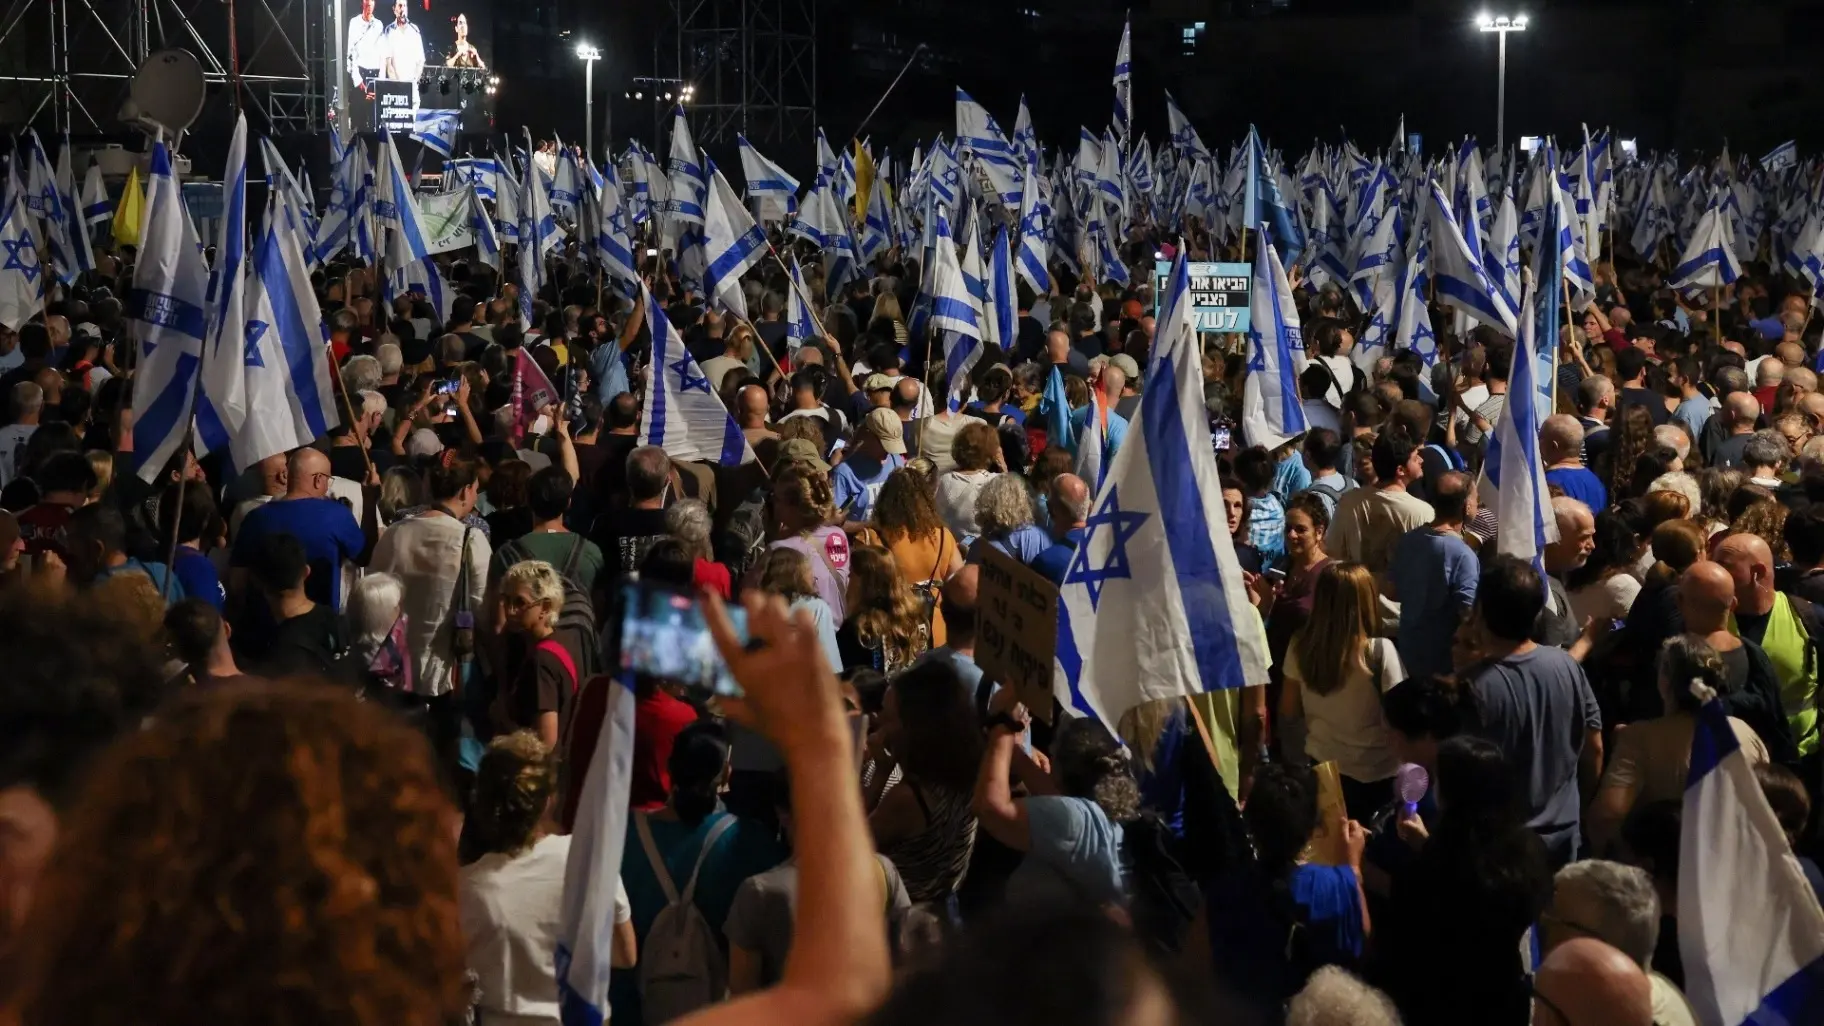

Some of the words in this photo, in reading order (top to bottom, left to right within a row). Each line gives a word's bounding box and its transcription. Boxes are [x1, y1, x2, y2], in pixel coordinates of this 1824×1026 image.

[1191, 277, 1209, 290] את
[1213, 277, 1247, 290] הביאו
[1192, 293, 1227, 305] הצבי
[1193, 308, 1239, 329] לשל
